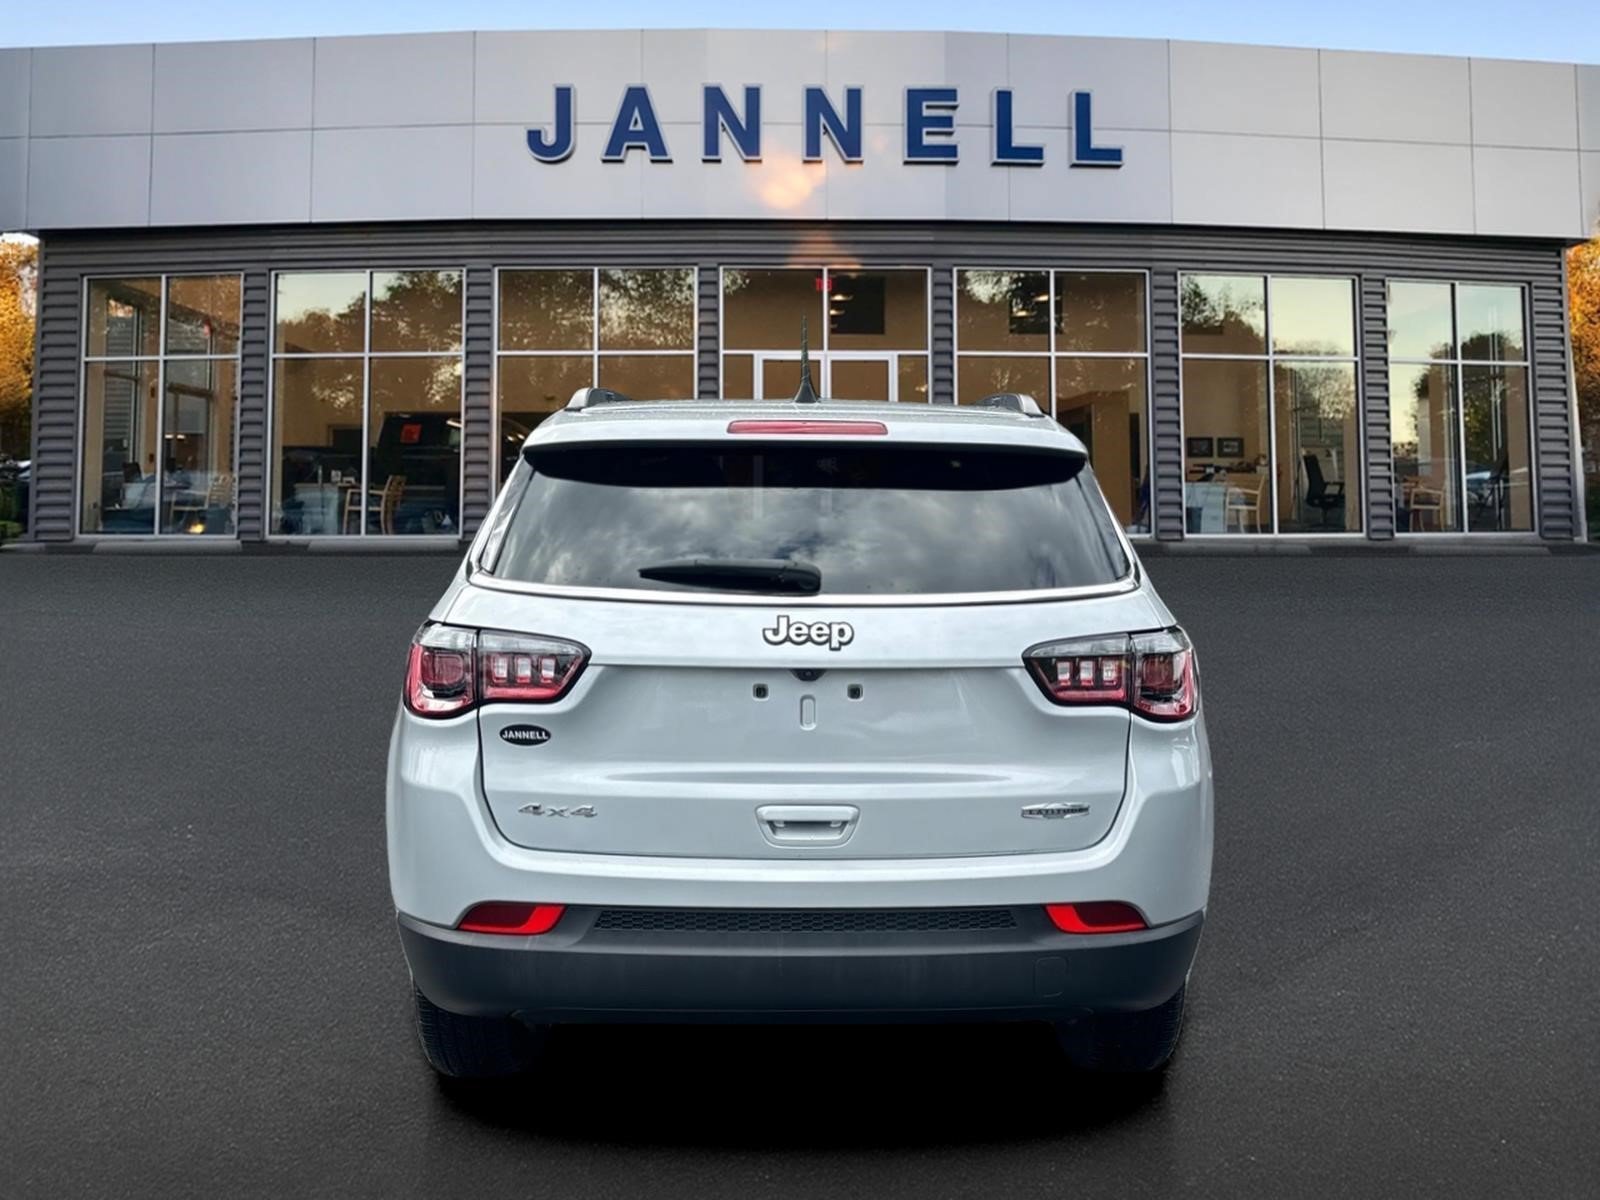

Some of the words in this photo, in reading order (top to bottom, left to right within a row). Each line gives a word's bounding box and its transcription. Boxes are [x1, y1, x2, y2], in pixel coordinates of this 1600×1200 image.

[526, 84, 1125, 168] JANNELL
[762, 615, 855, 651] Jeep
[501, 729, 549, 740] JANNELL
